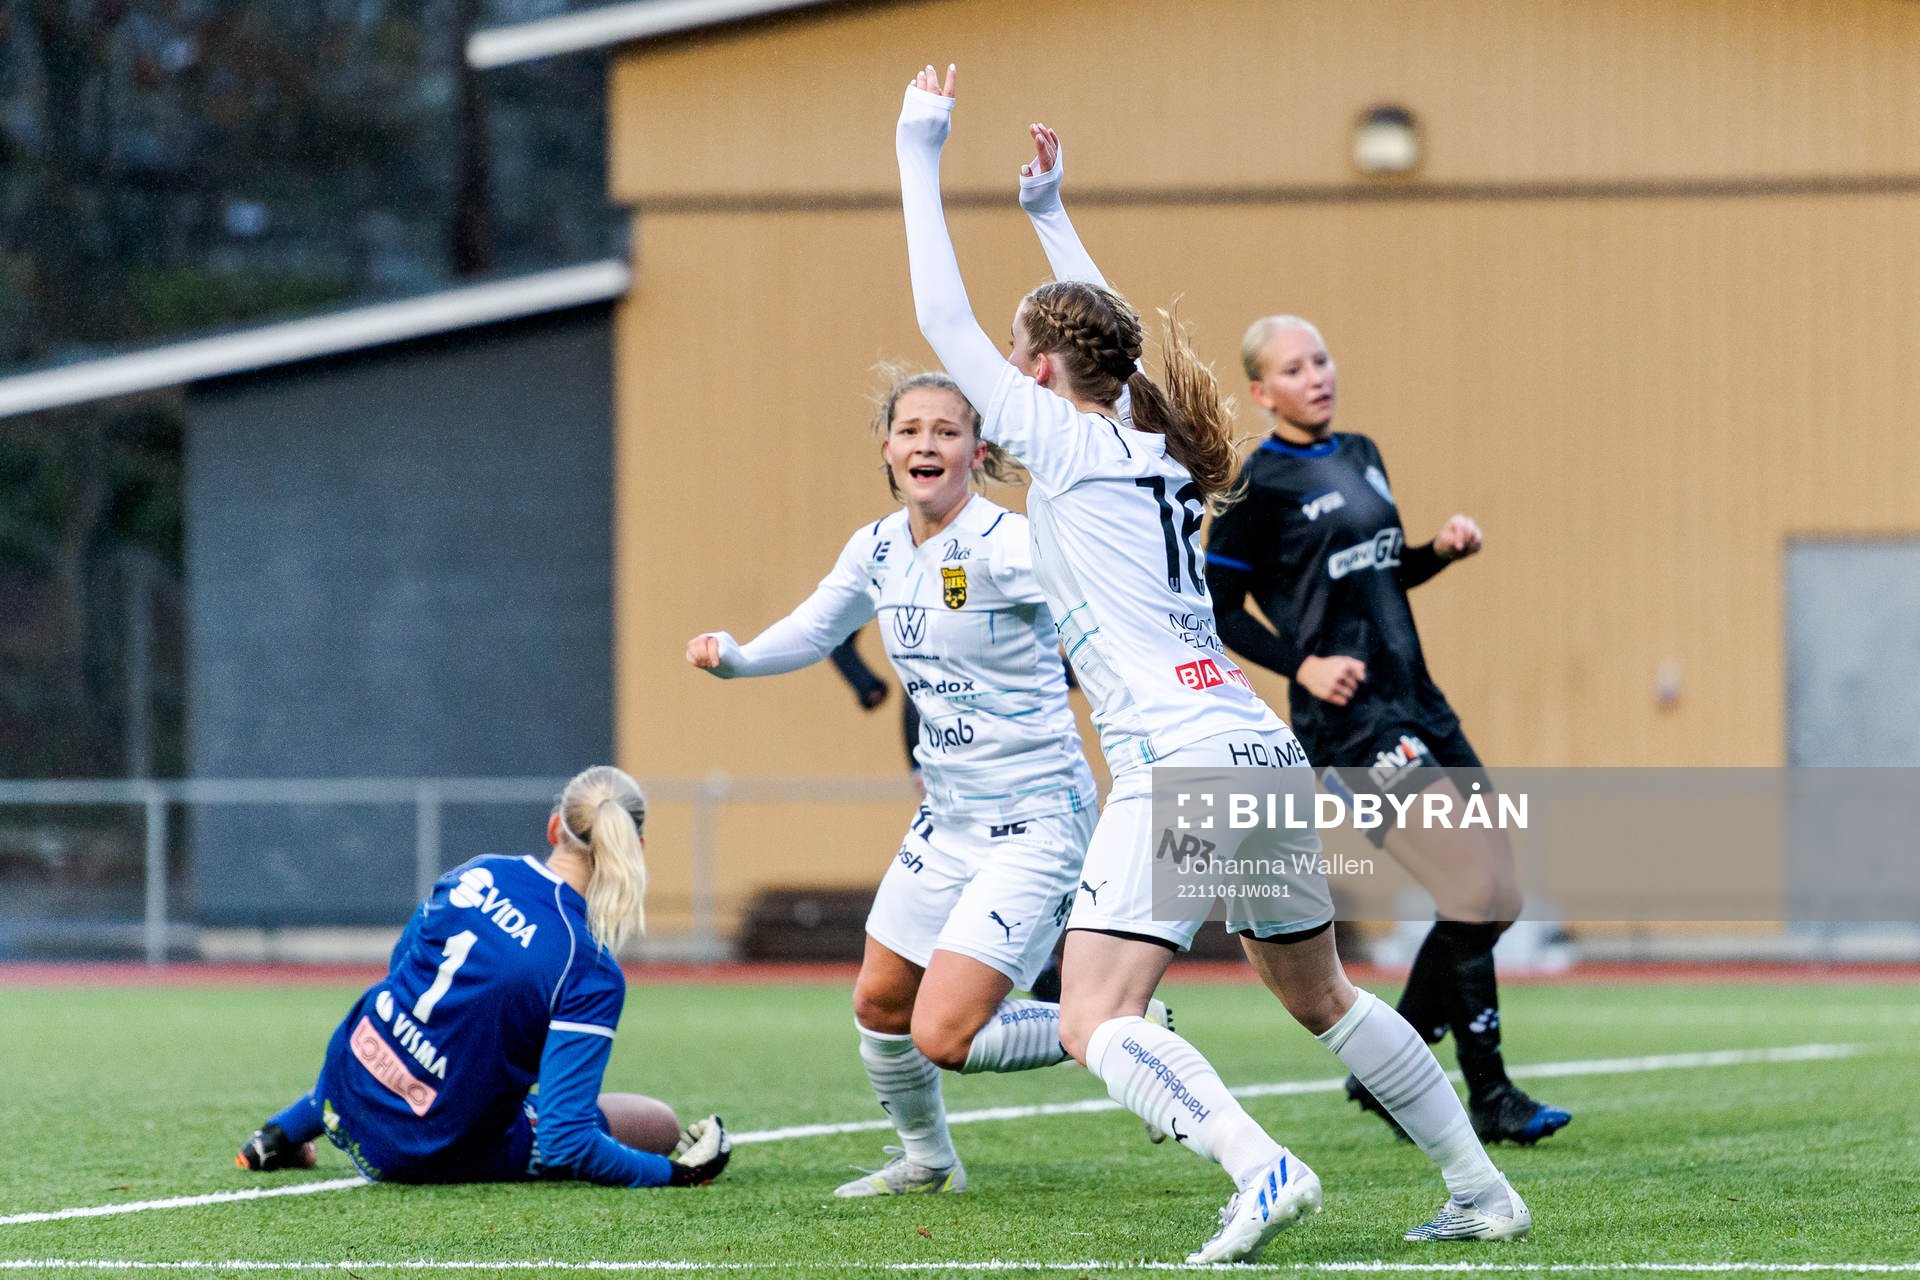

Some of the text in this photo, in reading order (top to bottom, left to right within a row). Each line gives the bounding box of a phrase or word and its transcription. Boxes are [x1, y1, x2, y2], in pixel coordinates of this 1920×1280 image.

[1135, 476, 1205, 596] 16
[1228, 739, 1306, 769] HOLME
[480, 887, 539, 949] VIDA
[411, 930, 478, 1024] 1
[354, 1022, 428, 1106] LOHILO
[392, 1012, 448, 1081] VISMA
[1122, 1036, 1211, 1124] Handelsbanken
